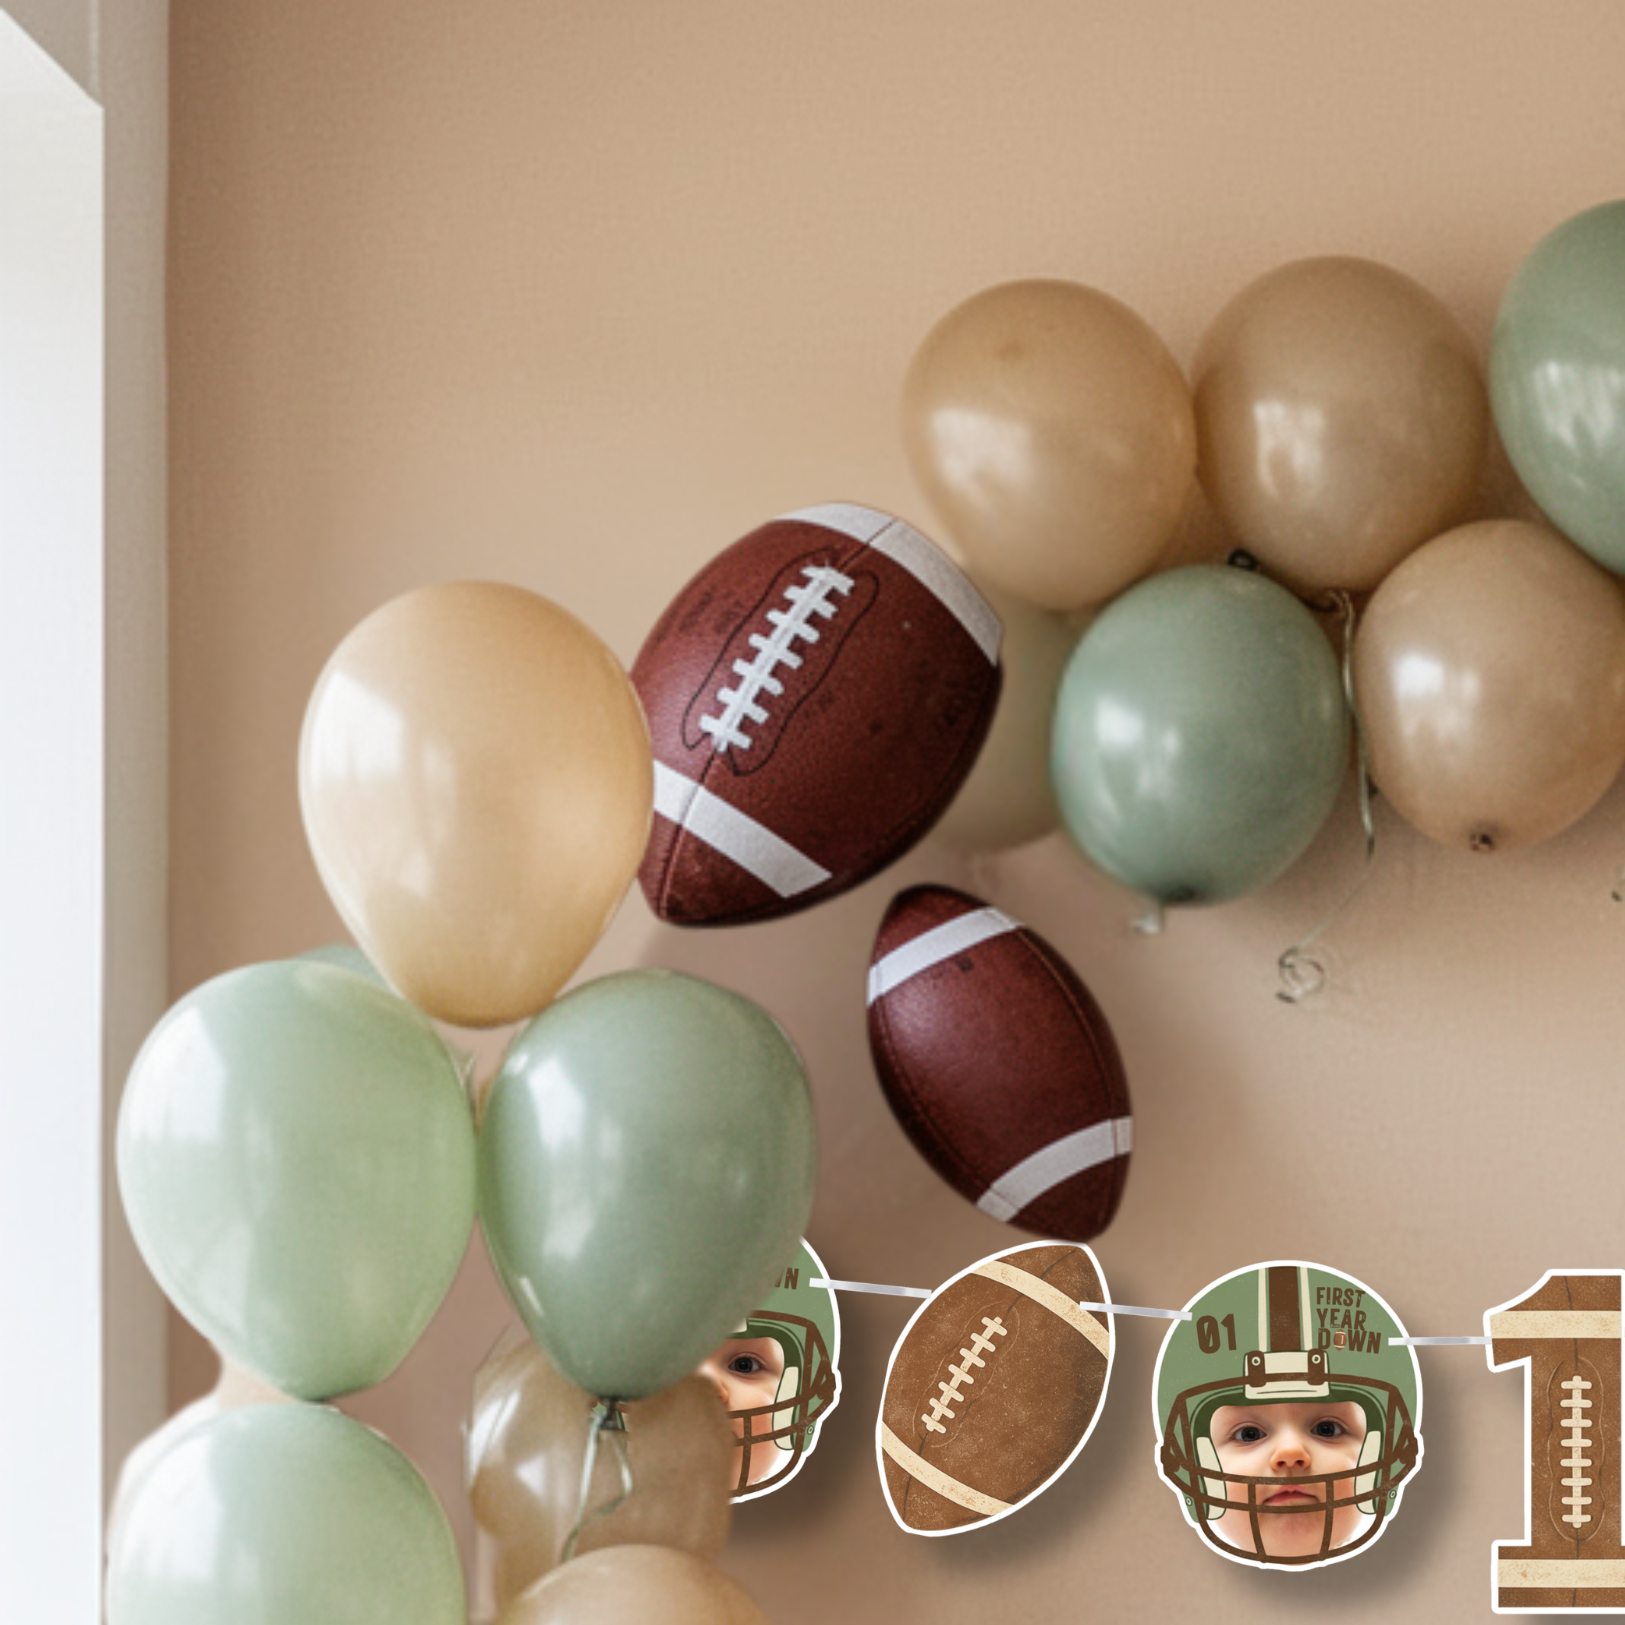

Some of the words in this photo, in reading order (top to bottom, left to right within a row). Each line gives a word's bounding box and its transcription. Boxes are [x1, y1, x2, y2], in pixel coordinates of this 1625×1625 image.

[1316, 1287, 1366, 1308] FIRST
[1316, 1308, 1366, 1331] YEAR
[1196, 1313, 1237, 1354] 01
[1318, 1328, 1381, 1354] DOWN
